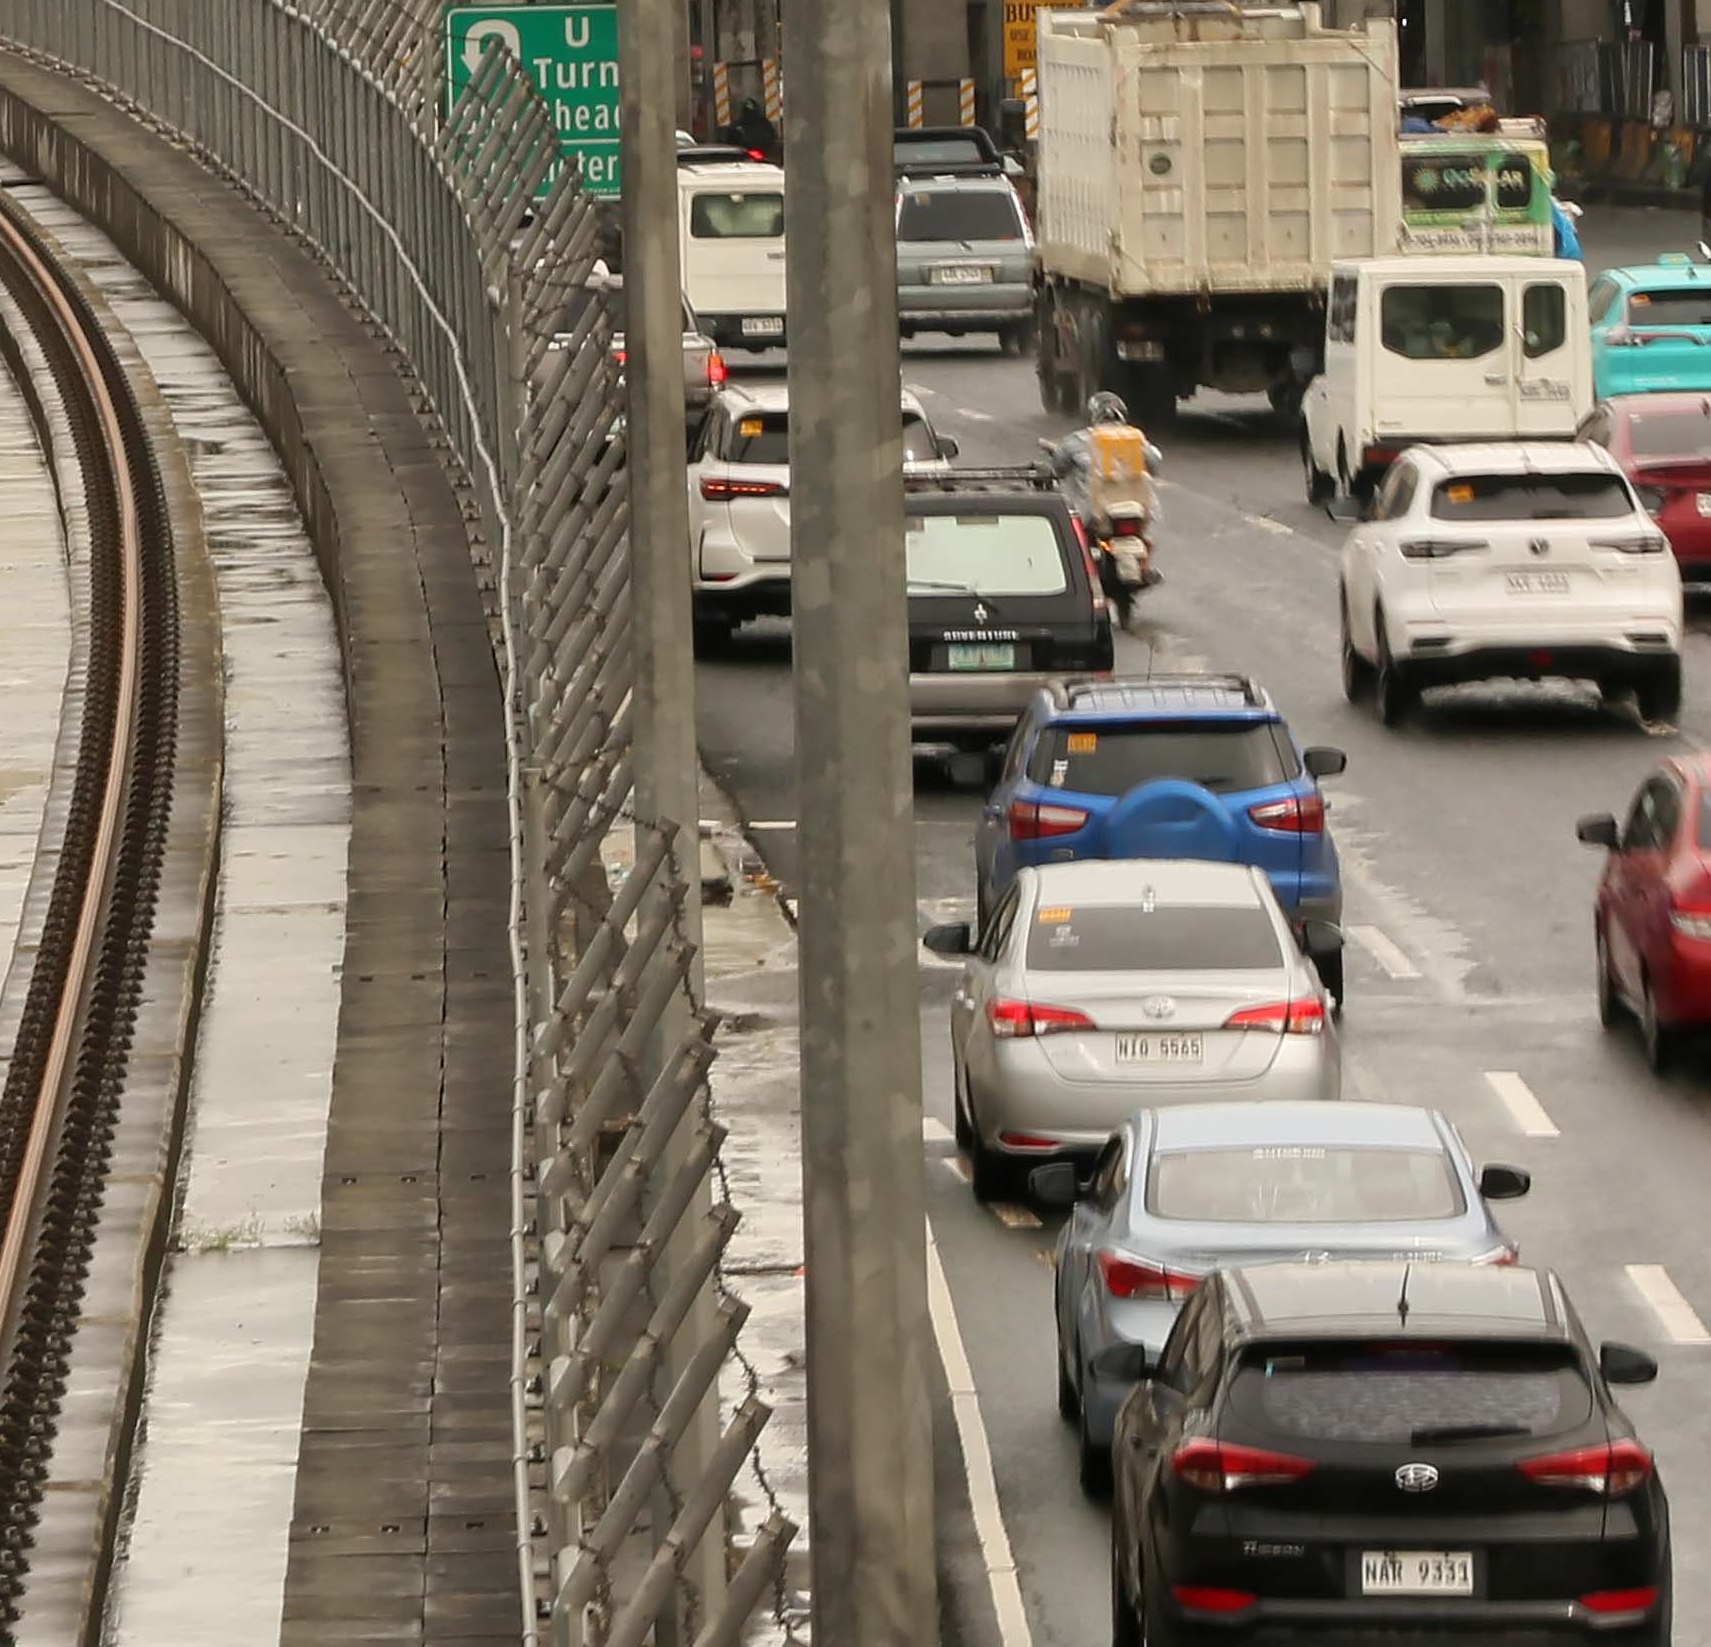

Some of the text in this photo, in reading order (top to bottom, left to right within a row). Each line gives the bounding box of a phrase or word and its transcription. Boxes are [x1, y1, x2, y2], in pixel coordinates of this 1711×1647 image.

[564, 16, 590, 47] U
[533, 57, 619, 90] Turn
[542, 98, 619, 132] hea
[1366, 1559, 1469, 1582] NAR 9331
